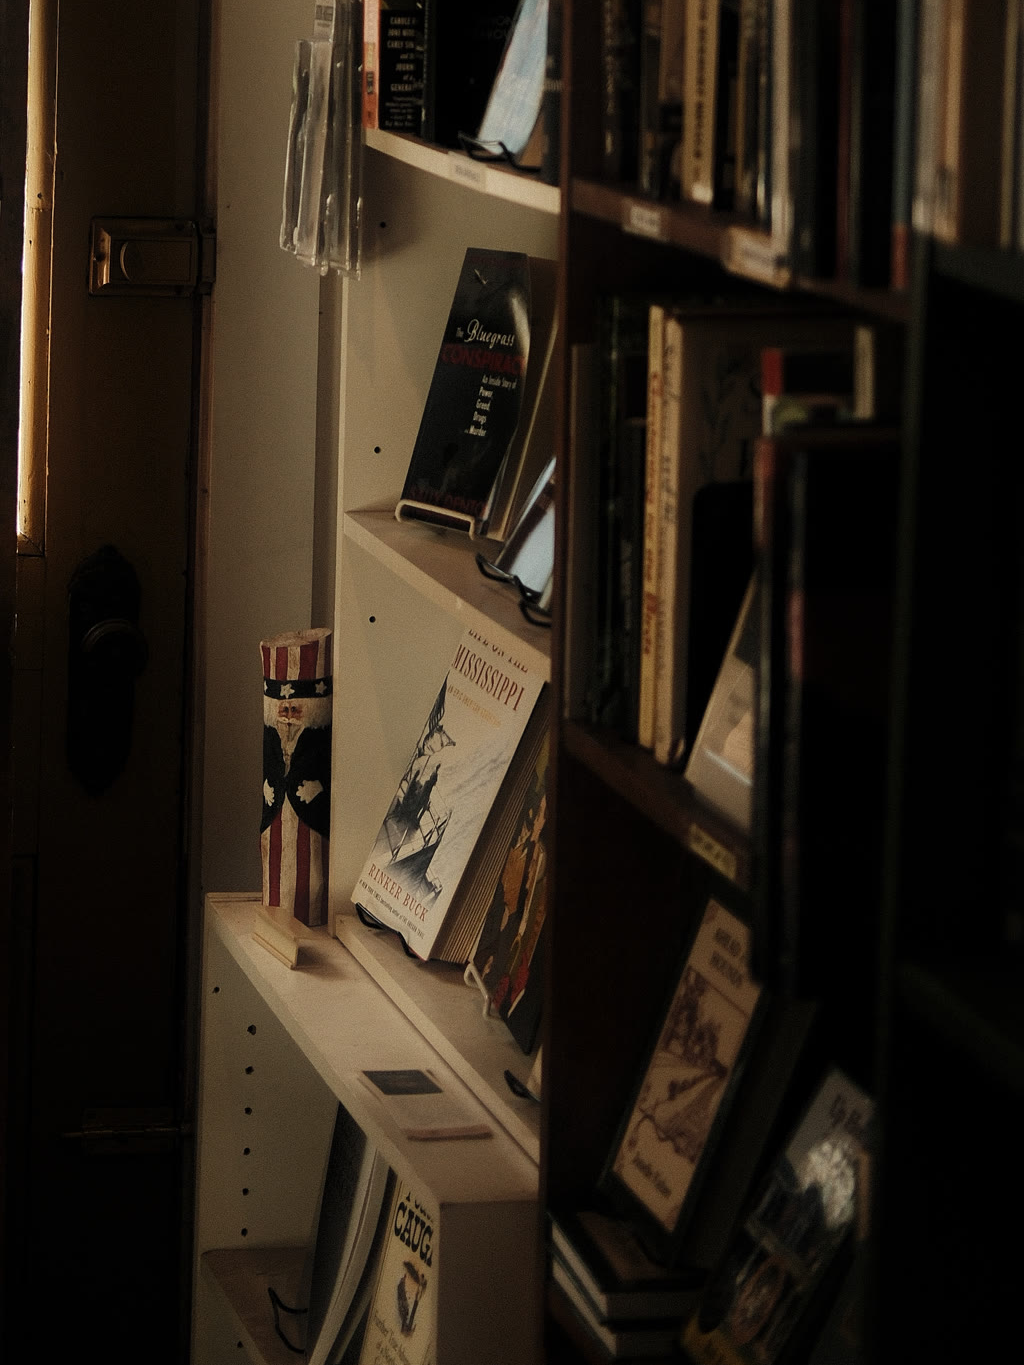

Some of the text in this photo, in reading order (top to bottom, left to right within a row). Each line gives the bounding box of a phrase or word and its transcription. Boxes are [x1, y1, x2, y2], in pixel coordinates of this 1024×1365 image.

[464, 318, 516, 349] Bluegrass
[453, 644, 525, 711] MISSISSIPPI
[368, 863, 403, 900] RINKER
[402, 892, 429, 922] BUCK
